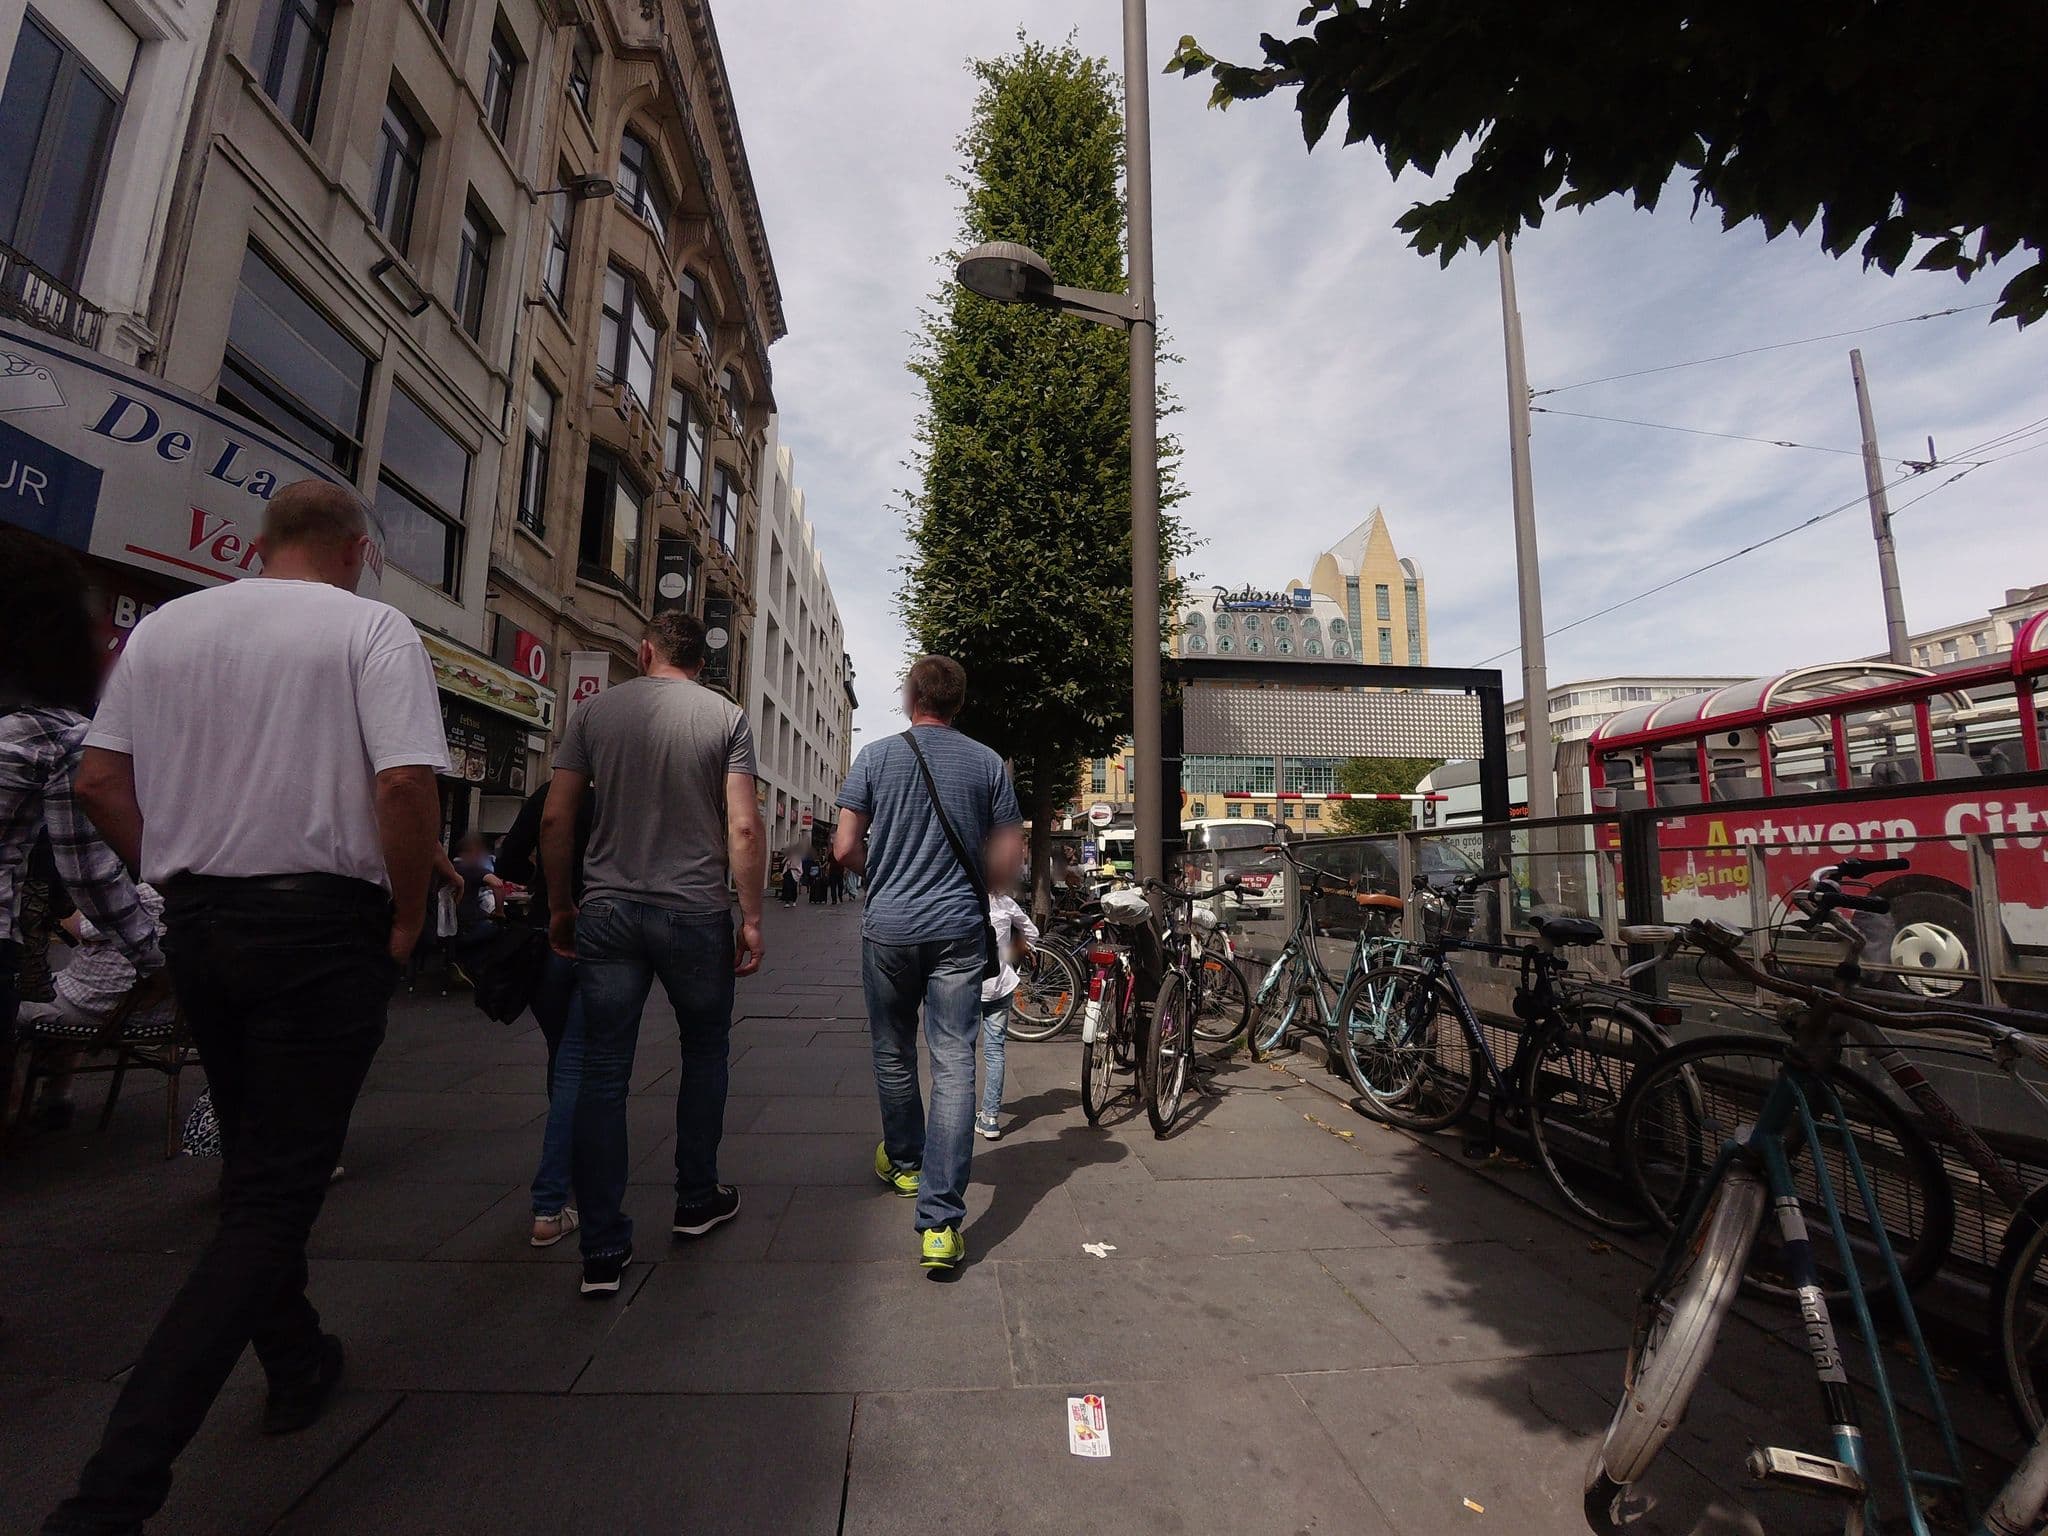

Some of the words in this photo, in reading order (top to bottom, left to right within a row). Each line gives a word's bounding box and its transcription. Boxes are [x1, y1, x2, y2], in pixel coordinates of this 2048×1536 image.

[83, 391, 192, 461] De
[1211, 583, 1292, 612] Radisson
[1705, 818, 1918, 860] Antwerp
